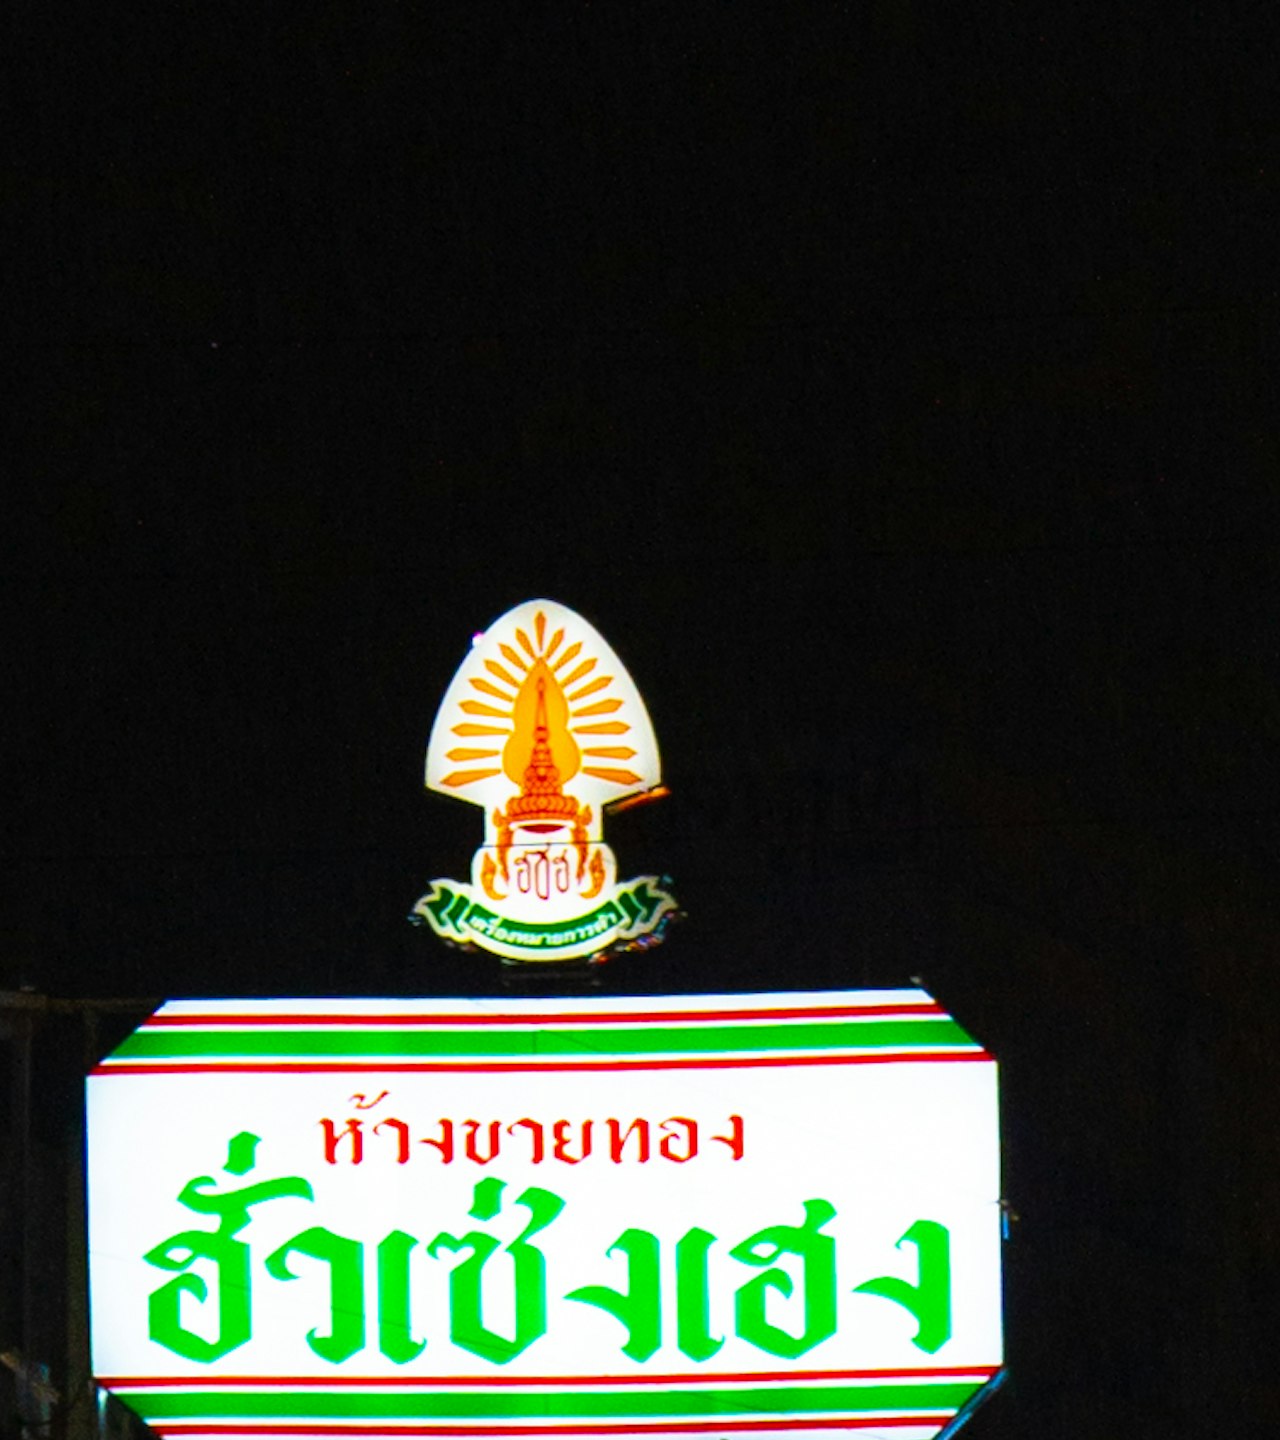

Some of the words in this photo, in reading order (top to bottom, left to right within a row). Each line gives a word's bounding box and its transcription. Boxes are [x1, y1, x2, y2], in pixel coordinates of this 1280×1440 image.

[319, 1091, 745, 1166] ห้างขายทอง
[142, 1131, 956, 1367] ฮั่วเซ่งเฮง
